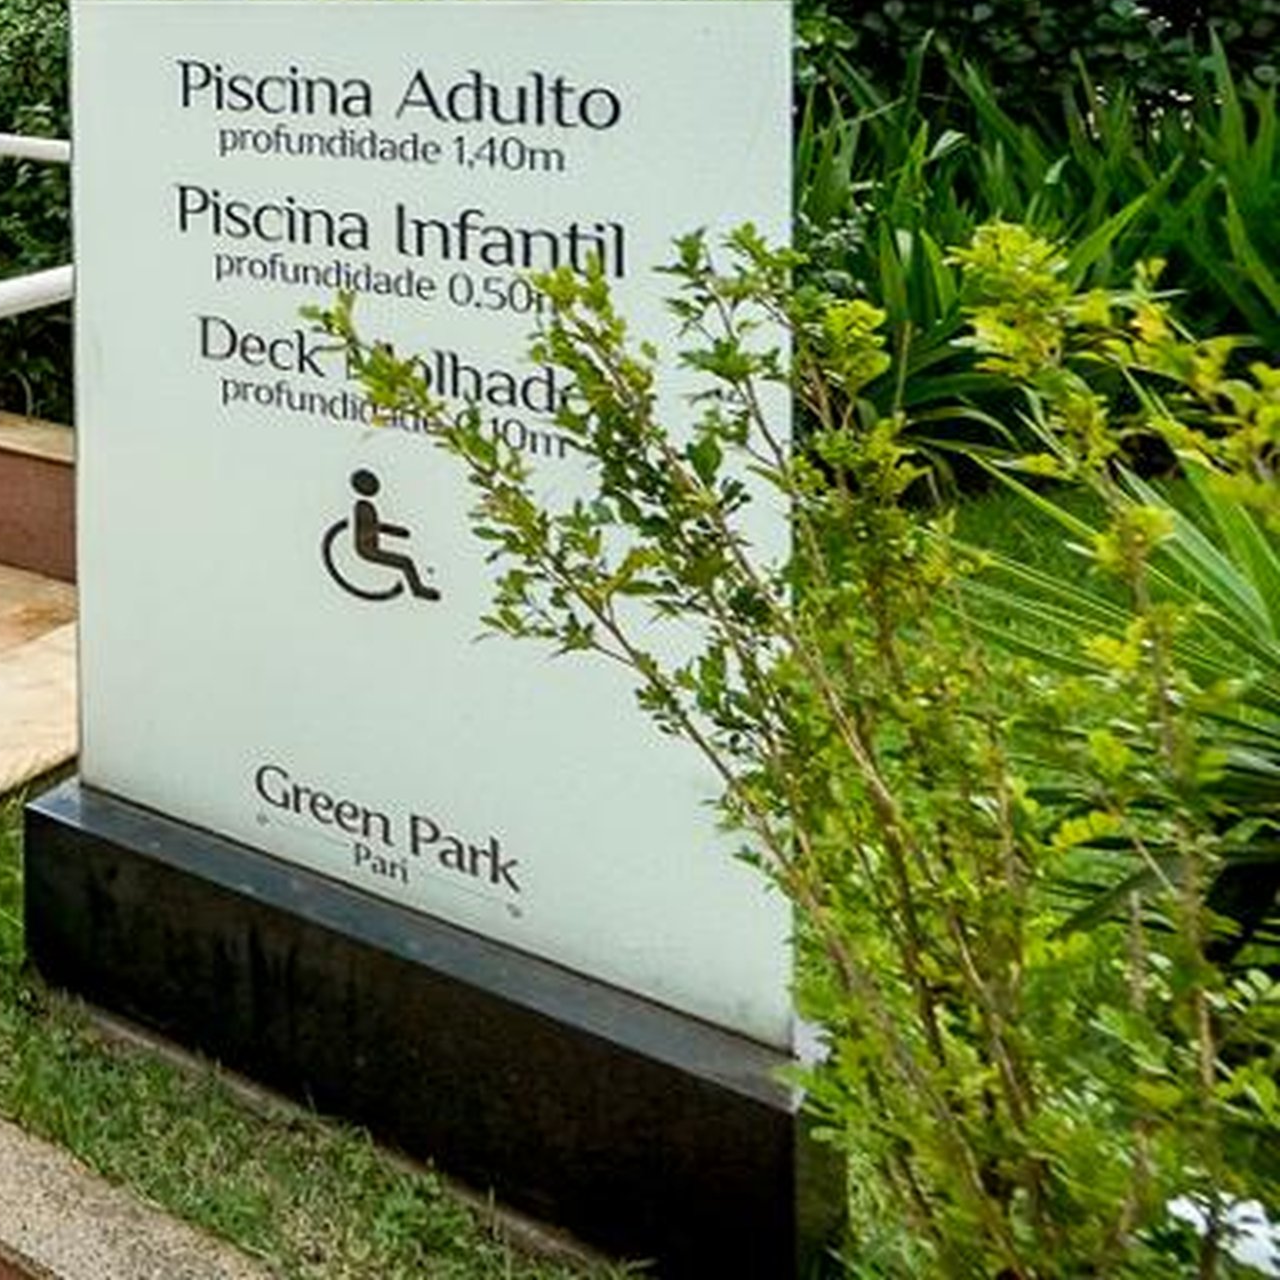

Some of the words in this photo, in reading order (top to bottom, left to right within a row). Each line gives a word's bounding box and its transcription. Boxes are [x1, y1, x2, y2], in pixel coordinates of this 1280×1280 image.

[177, 60, 371, 117] Piscina
[395, 69, 620, 130] Adulto
[219, 123, 441, 164] profundidade
[453, 135, 565, 171] 1,40m
[174, 184, 368, 250] Piscina
[396, 204, 624, 278] Infantil
[215, 253, 436, 300] profundidade
[200, 316, 325, 377] Deck
[255, 765, 394, 847] Green
[409, 814, 521, 893] Park
[354, 842, 409, 884] Pari
